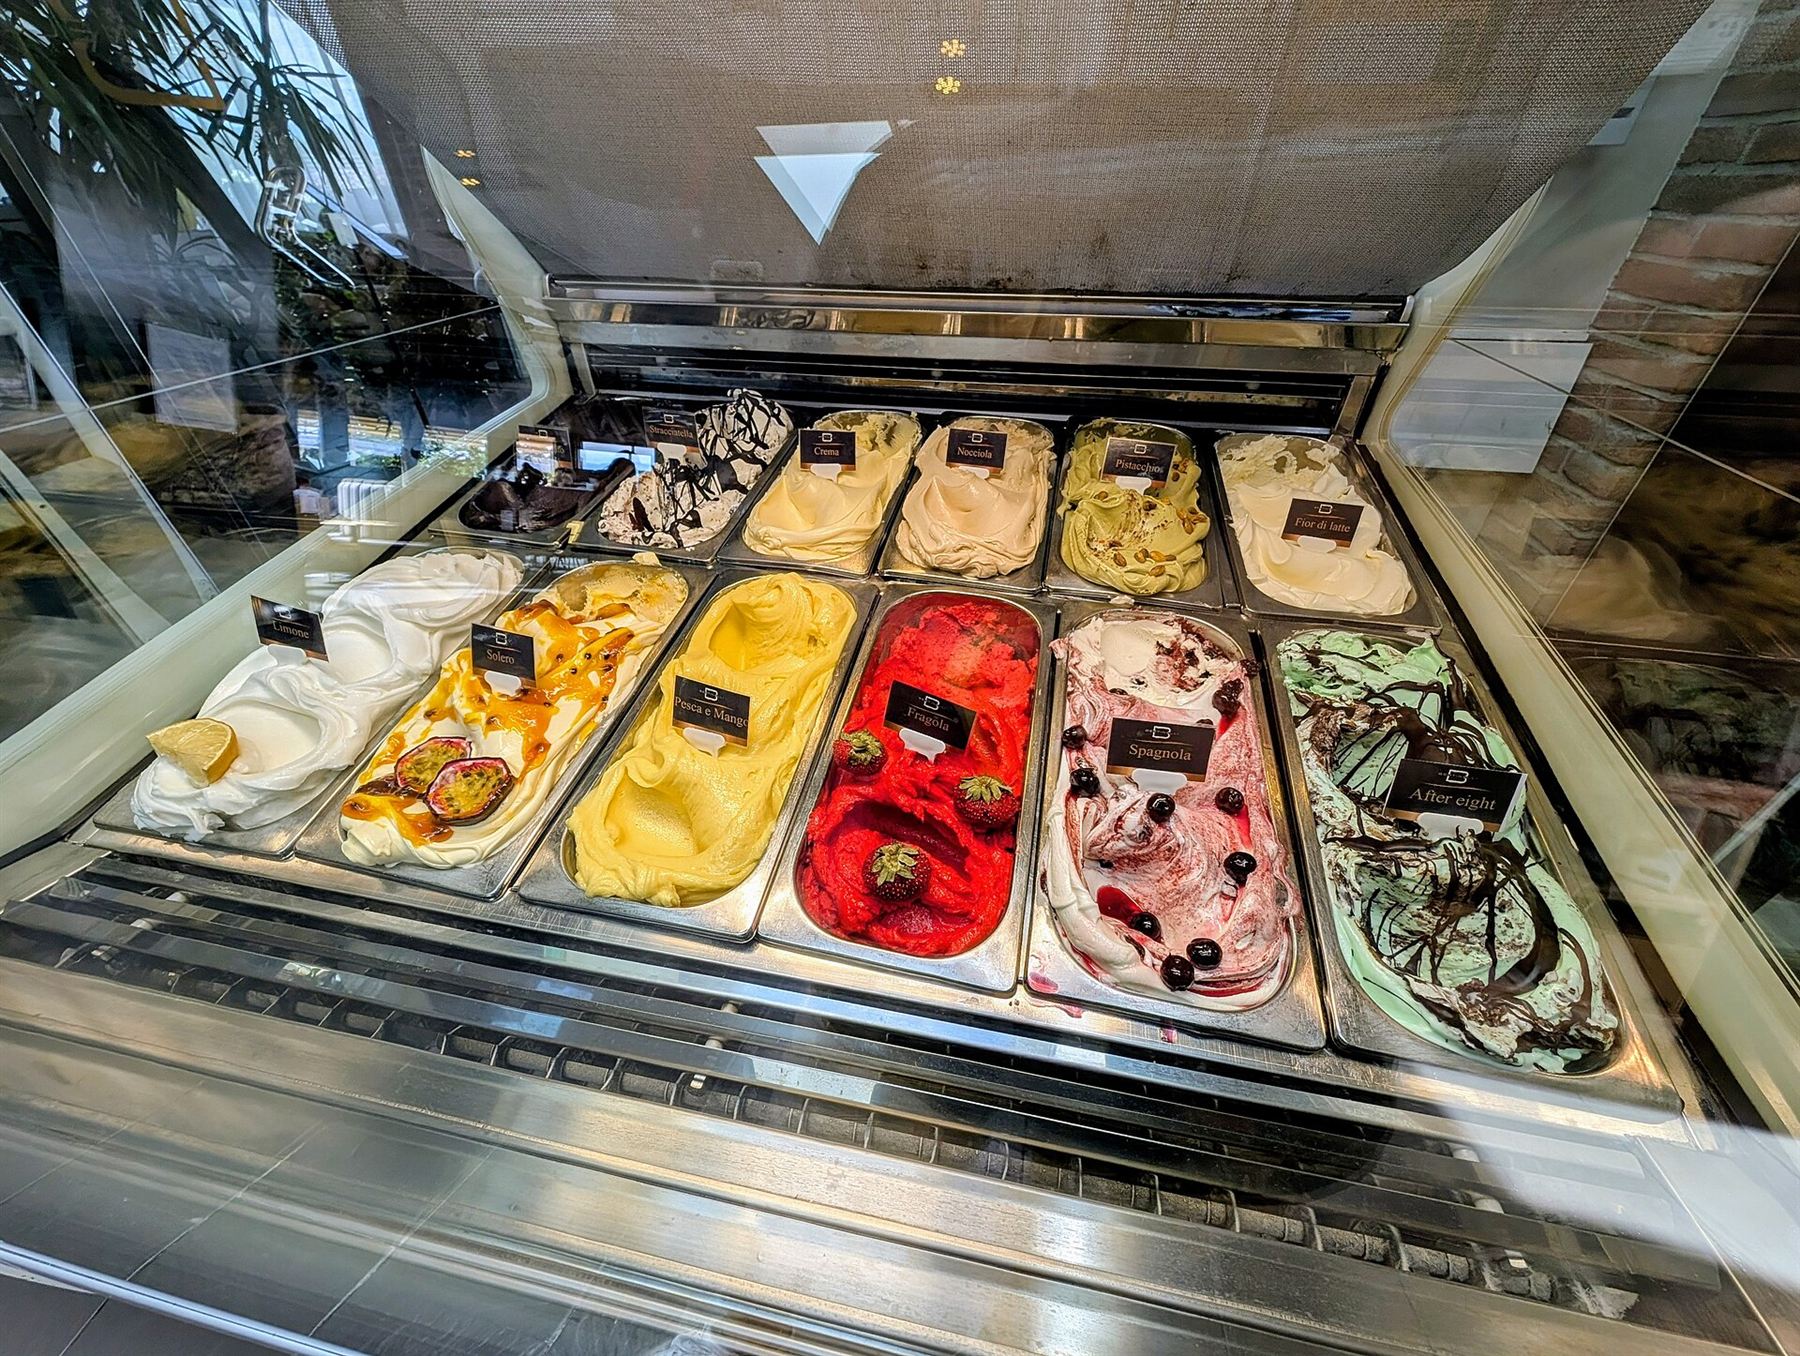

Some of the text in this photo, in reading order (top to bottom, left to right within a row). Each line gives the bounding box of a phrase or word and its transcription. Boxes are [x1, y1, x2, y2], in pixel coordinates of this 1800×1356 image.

[649, 425, 694, 439] Stracciatella
[814, 447, 839, 456] Crema
[957, 446, 992, 459] Nocciola
[1115, 459, 1160, 473] Pistacchio
[1295, 517, 1351, 533] Fior di latte
[272, 620, 310, 639] Limone
[486, 649, 515, 665] Solero
[674, 696, 702, 714] Pesca
[704, 707, 711, 716] e
[1129, 743, 1191, 761] Spagnola
[1409, 788, 1497, 811] After eight
